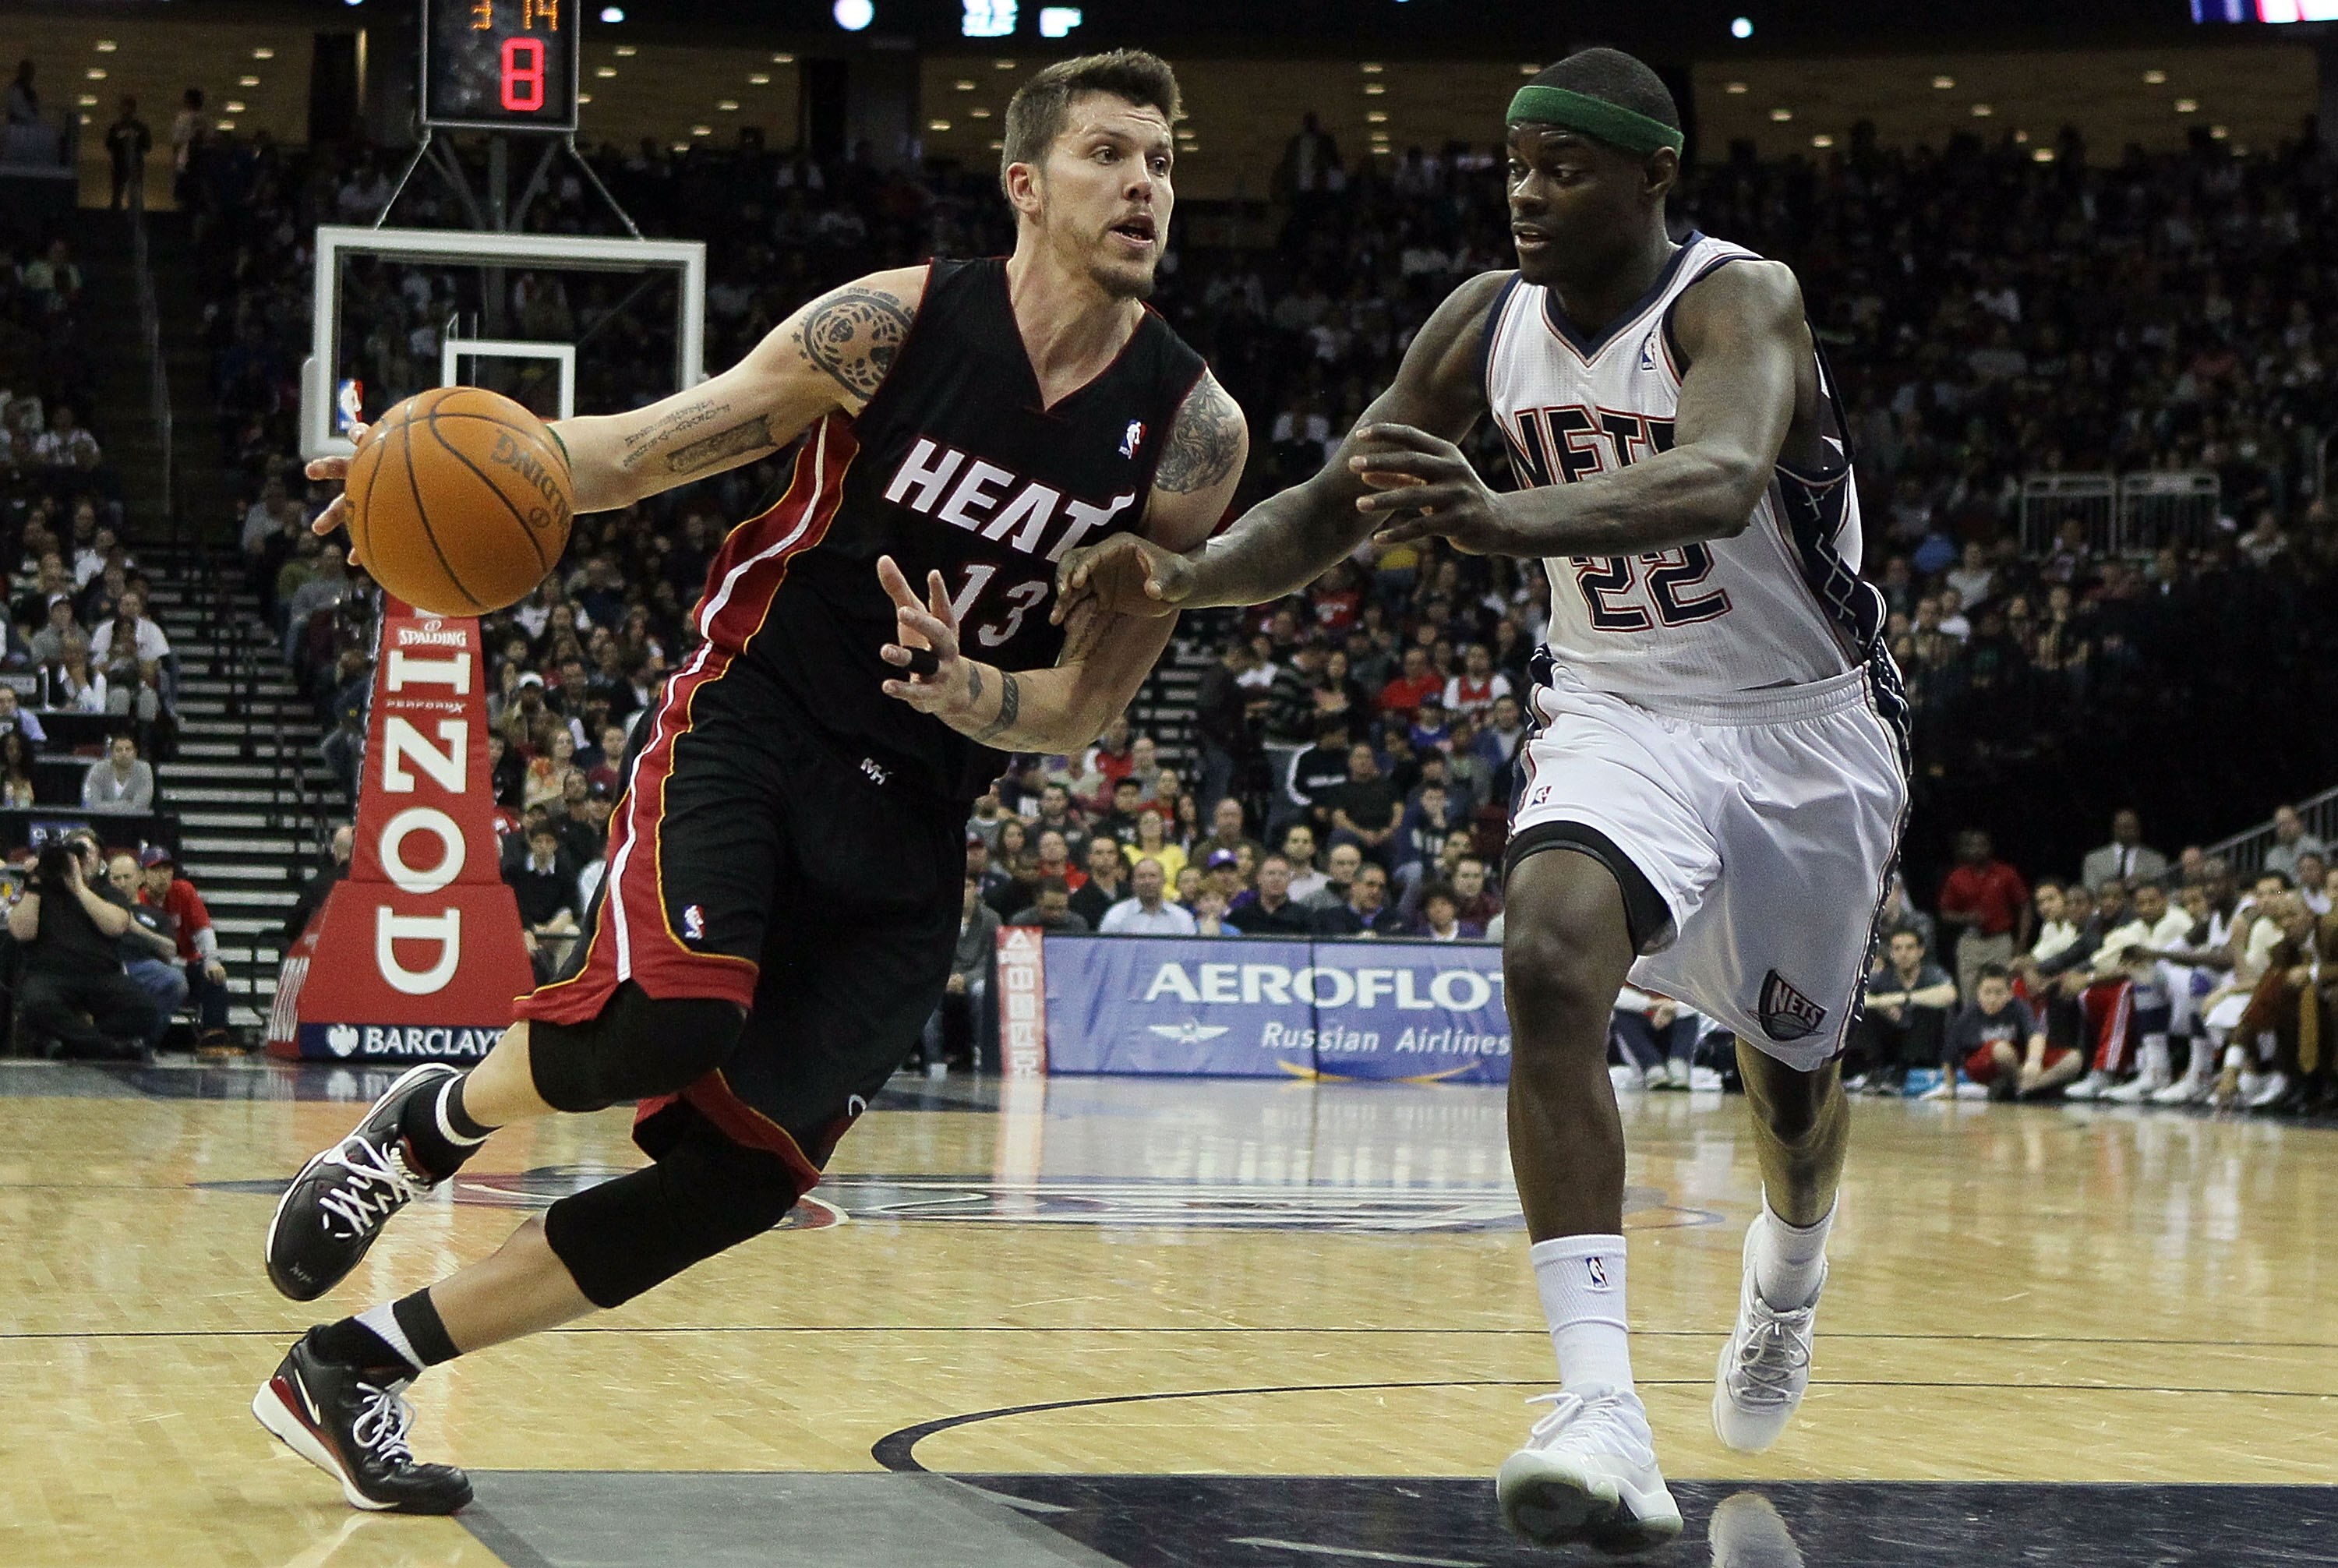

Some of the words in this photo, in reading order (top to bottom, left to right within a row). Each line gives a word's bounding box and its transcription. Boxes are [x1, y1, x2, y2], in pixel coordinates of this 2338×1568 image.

[501, 37, 545, 111] 8
[884, 436, 1136, 563] HEAT
[952, 563, 1048, 648] 13
[1568, 542, 1733, 632] 22
[398, 627, 467, 647] SPALDING
[376, 648, 471, 996] IZOD
[1261, 1022, 1379, 1053] Russian
[1396, 1027, 1510, 1057] Airlines
[1768, 980, 1819, 1030] NETS
